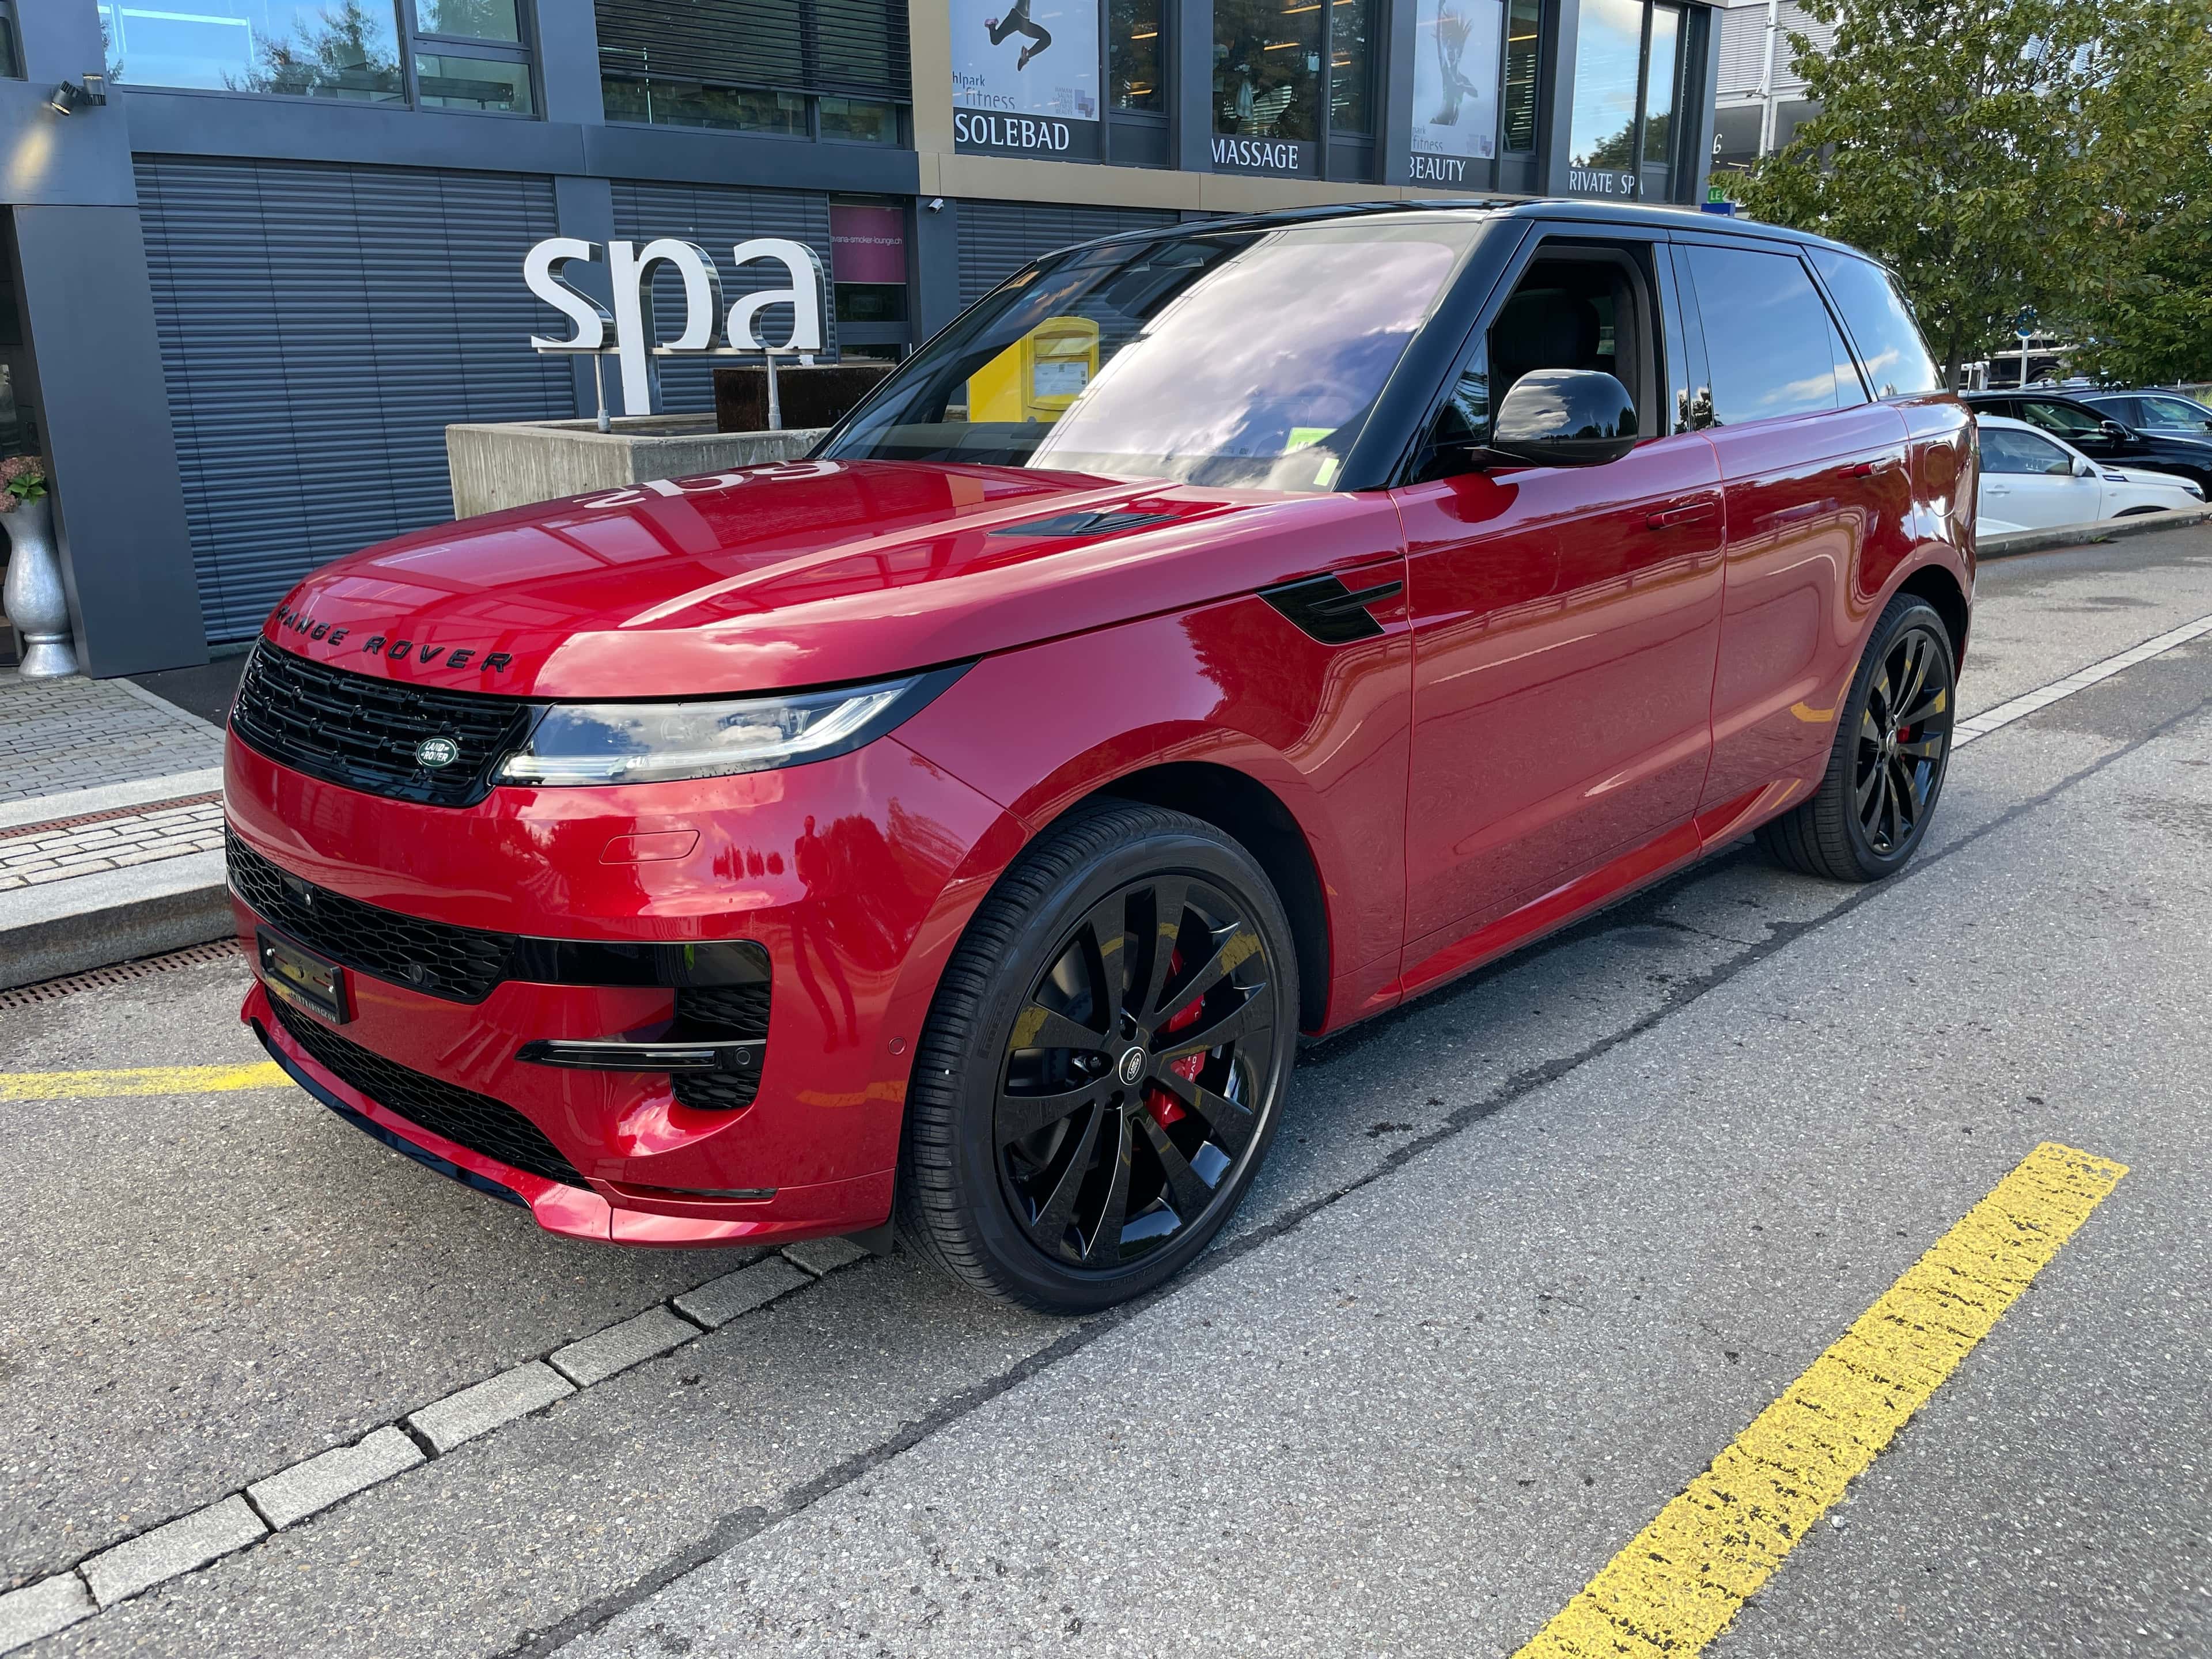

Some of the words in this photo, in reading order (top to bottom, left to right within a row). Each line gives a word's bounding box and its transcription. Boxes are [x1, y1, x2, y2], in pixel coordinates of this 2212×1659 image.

[966, 87, 1015, 109] fitness
[955, 113, 1070, 150] SOLEBAD
[1413, 135, 1442, 151] fitness
[1211, 138, 1298, 169] MASSAGE
[524, 238, 830, 416] spa
[275, 605, 349, 646] RANGE
[362, 635, 513, 673] ROVER
[423, 751, 449, 762] ROVER
